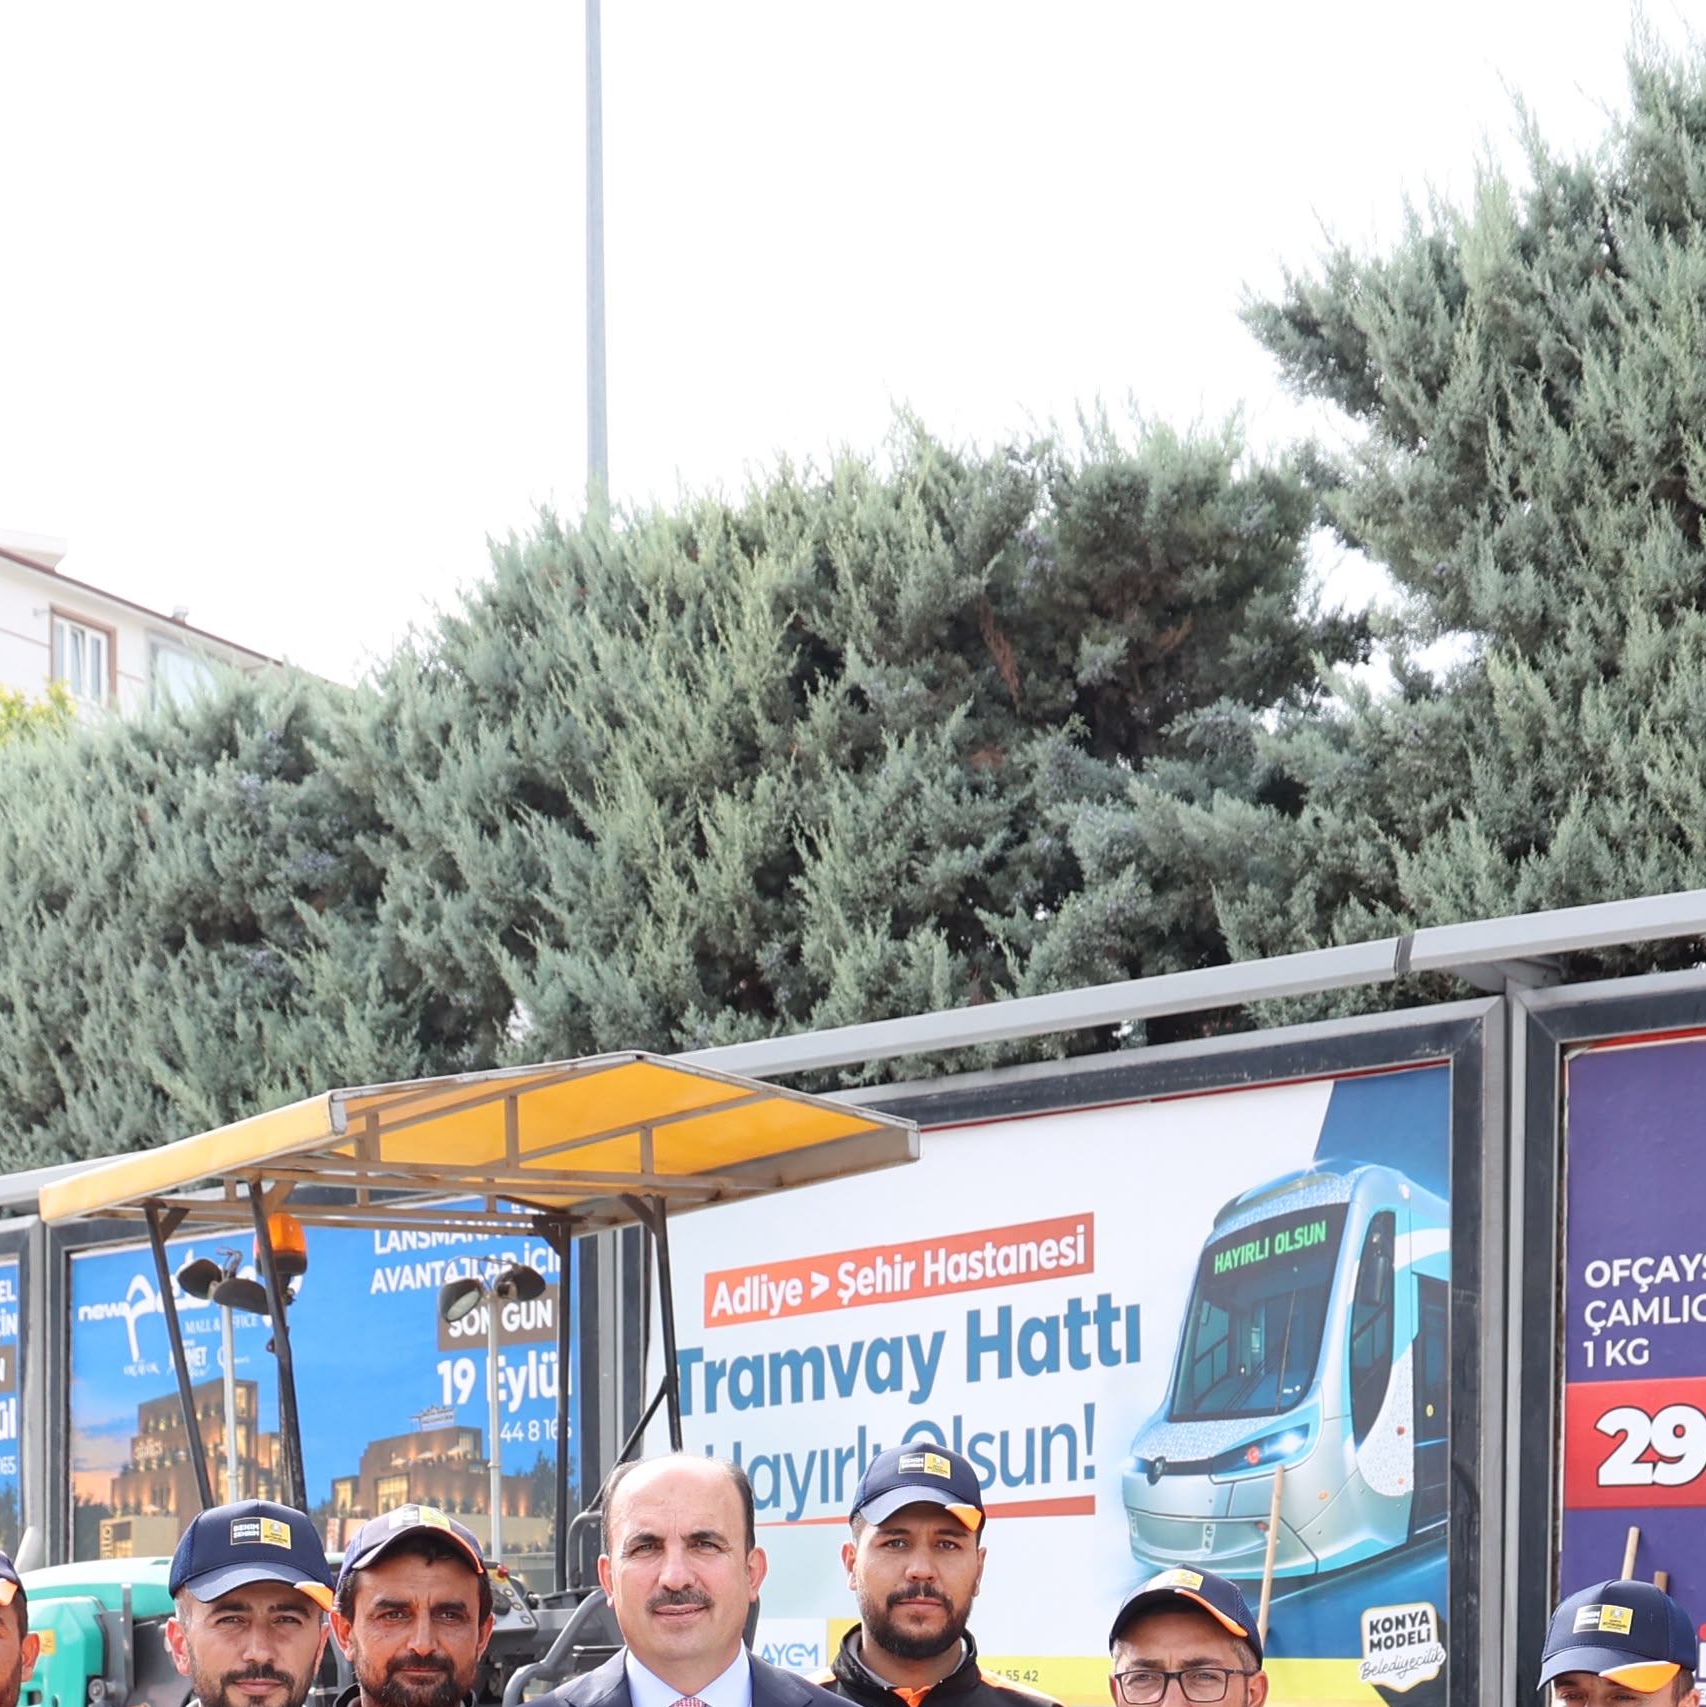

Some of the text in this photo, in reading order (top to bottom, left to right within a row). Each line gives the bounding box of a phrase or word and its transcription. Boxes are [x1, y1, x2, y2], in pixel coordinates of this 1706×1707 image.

[1214, 1220, 1326, 1274] HAYIRLI OLSUN
[710, 1224, 1087, 1318] Adliye Şehir Hastanesi
[676, 1292, 1141, 1418] Tramvay Hattı
[1583, 1338, 1650, 1368] 1 KG
[437, 1358, 476, 1406] 19
[528, 1420, 540, 1441] 8
[705, 1425, 882, 1522] ayırl
[1370, 1610, 1430, 1636] KONYA
[1370, 1628, 1431, 1653] MODELİ
[1023, 1670, 1039, 1682] 42
[1360, 1646, 1444, 1680] Belediyecilik
